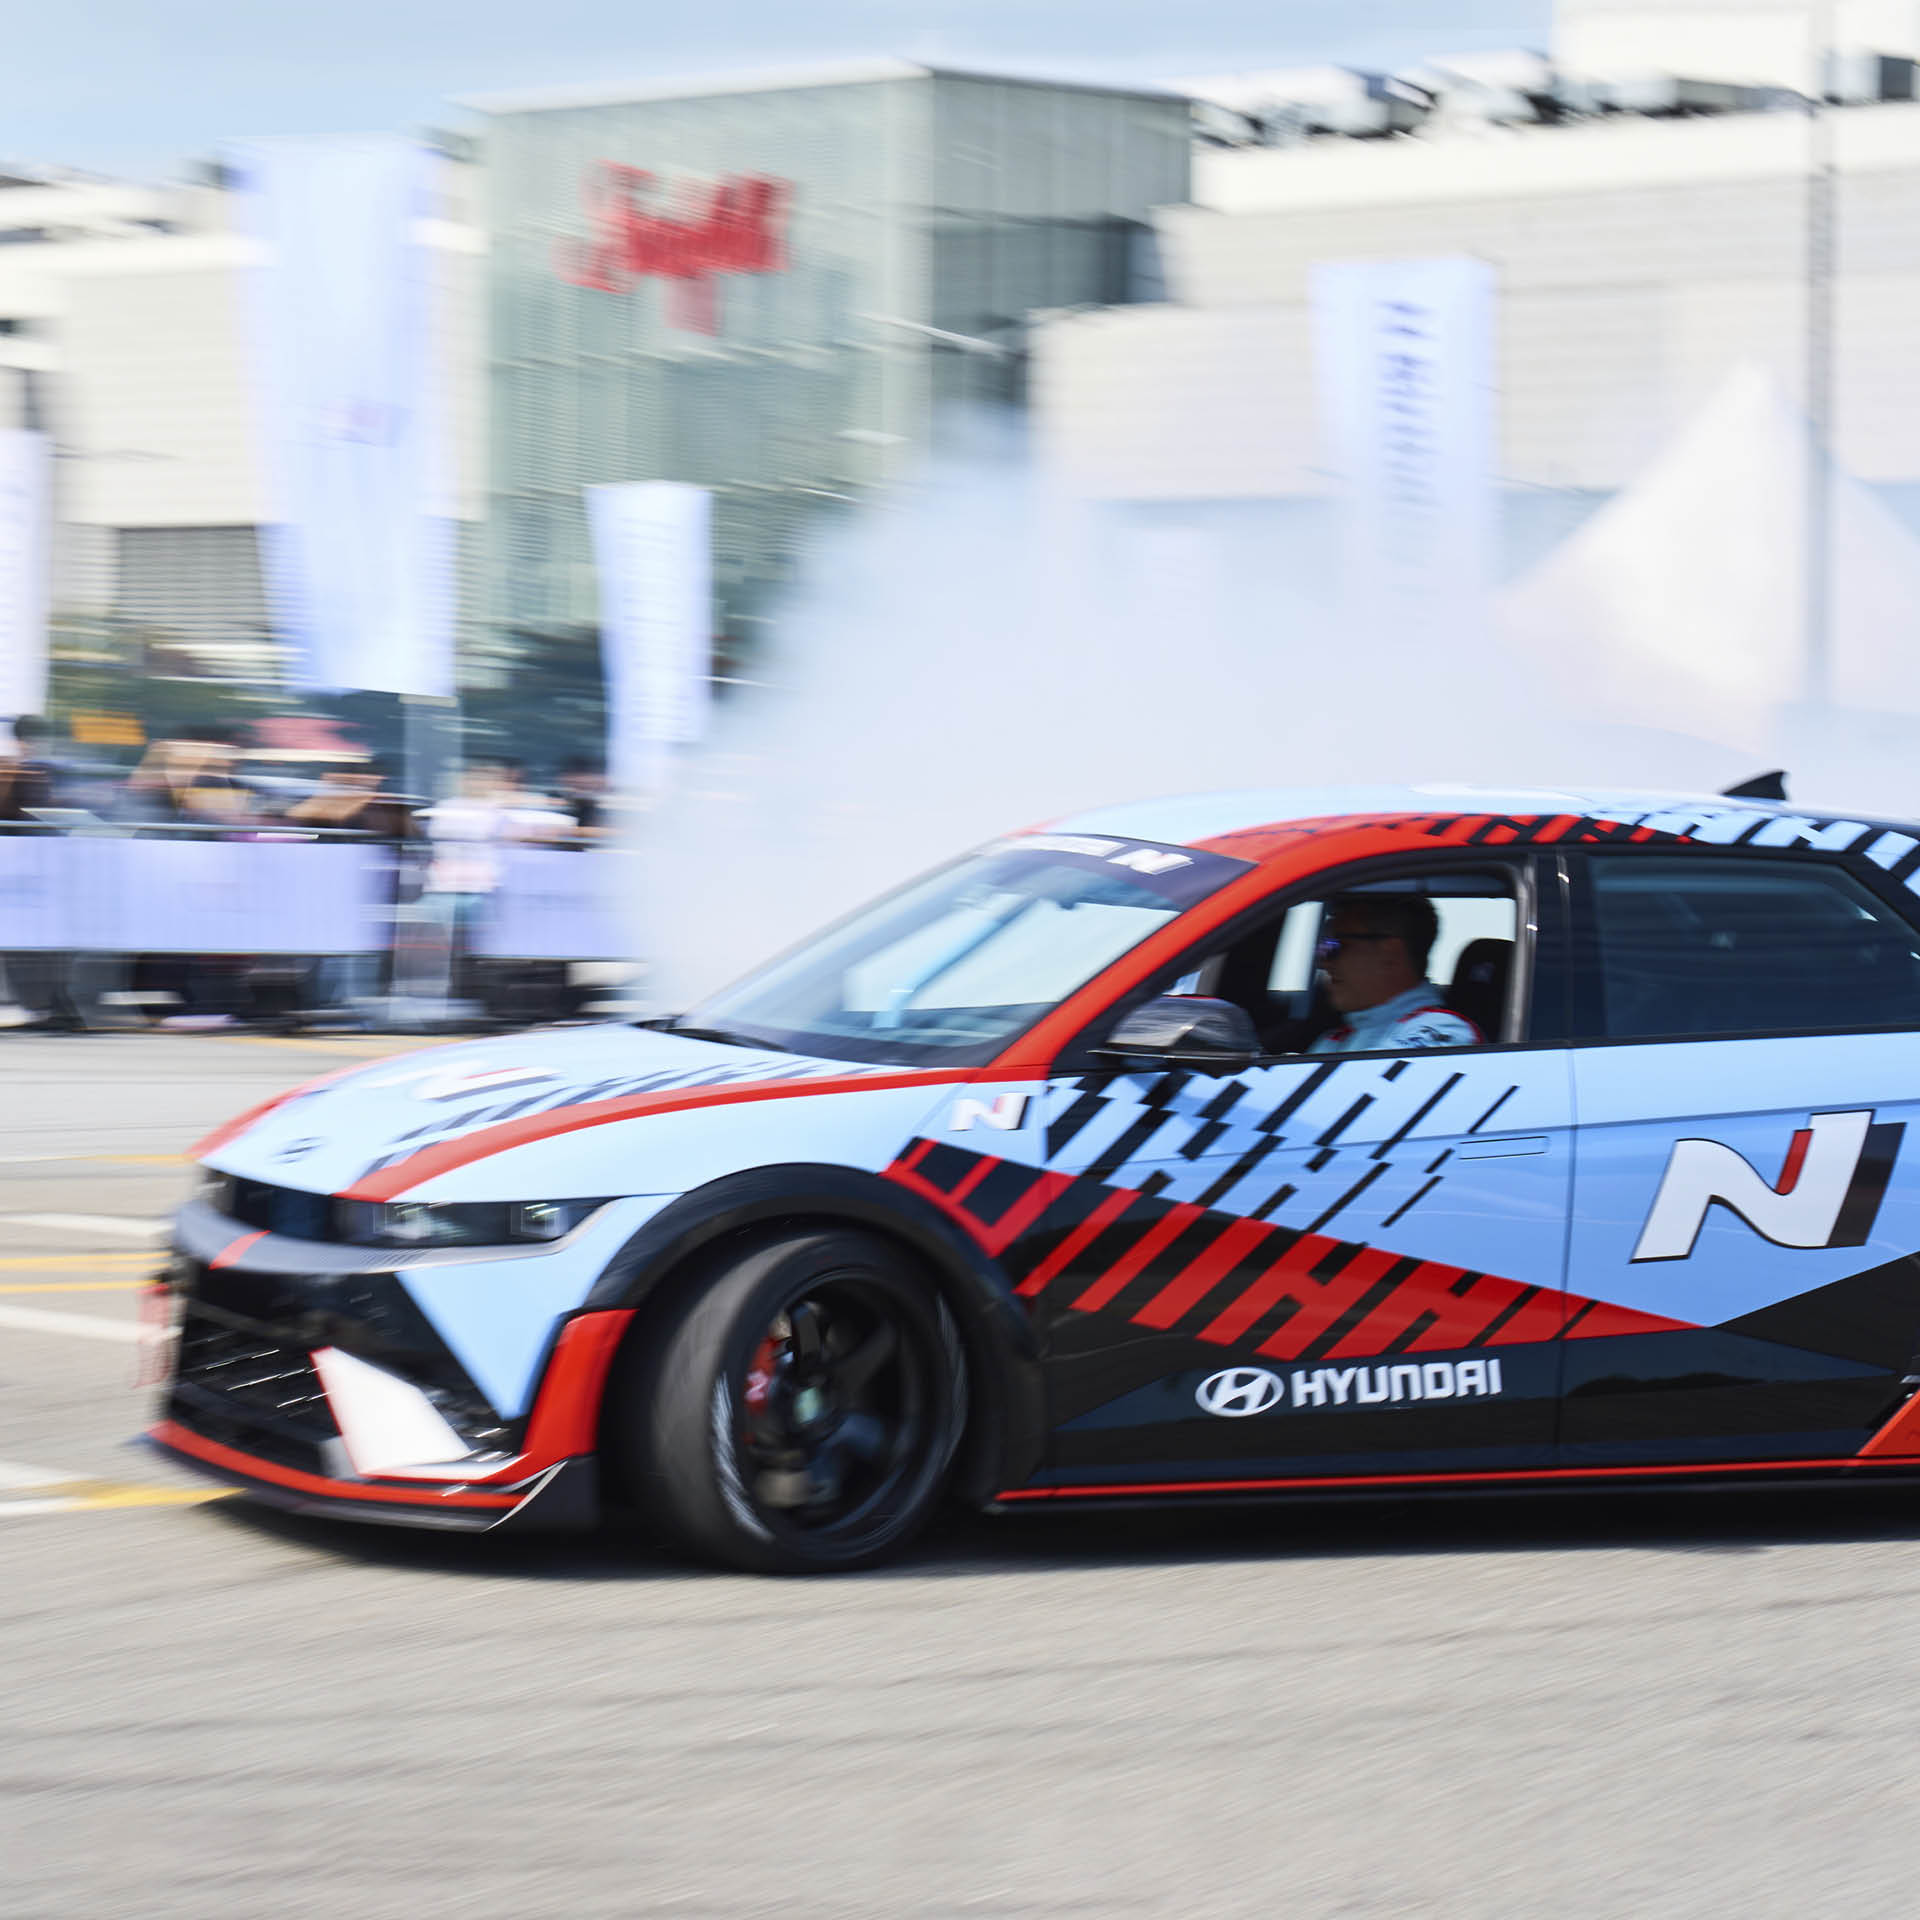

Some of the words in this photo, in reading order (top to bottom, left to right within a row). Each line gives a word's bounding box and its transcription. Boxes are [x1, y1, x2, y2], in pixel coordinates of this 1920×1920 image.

[948, 1092, 1028, 1131] N
[1629, 1108, 1890, 1264] N
[1291, 1359, 1502, 1407] HYUNDAI
